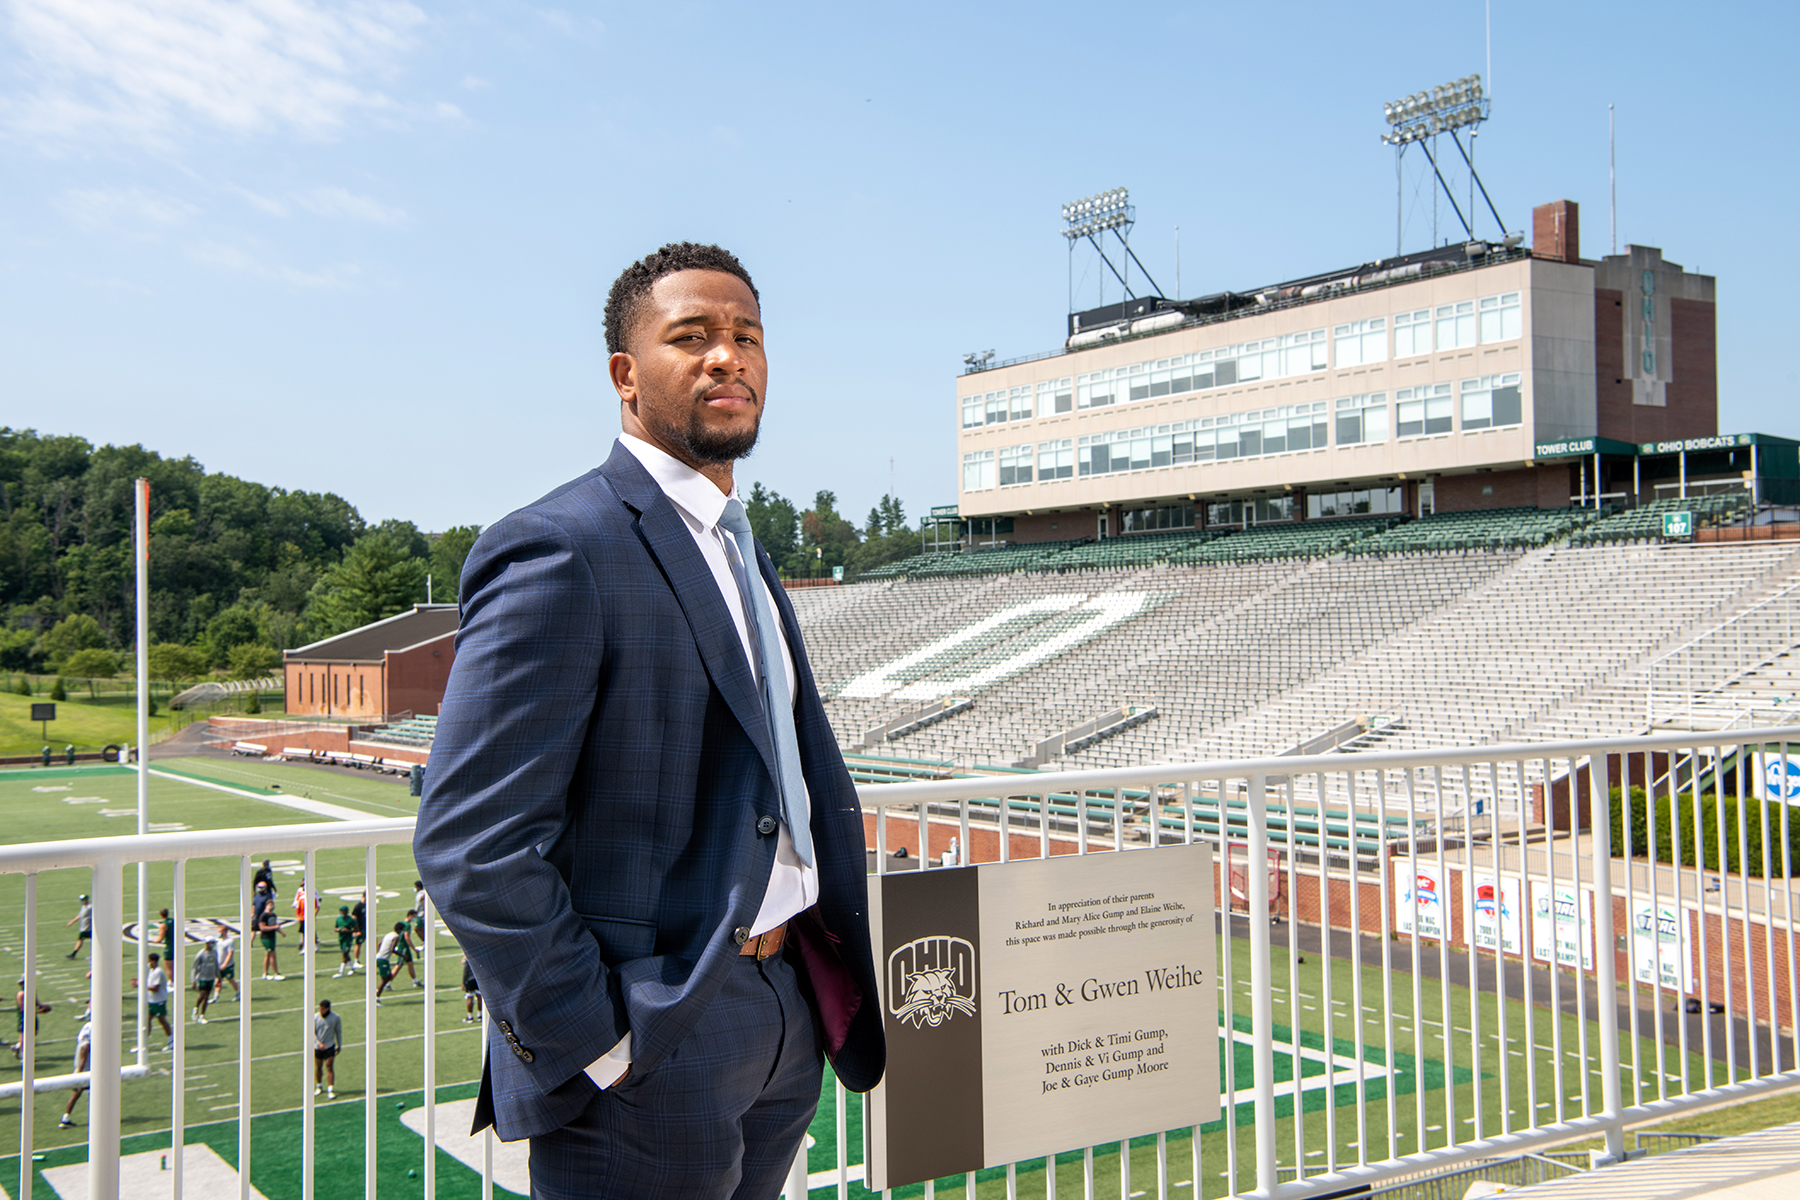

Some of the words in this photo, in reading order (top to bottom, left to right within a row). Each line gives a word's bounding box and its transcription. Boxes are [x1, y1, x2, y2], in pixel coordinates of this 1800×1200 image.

[1642, 271, 1655, 373] OHIO
[1536, 442, 1567, 456] TOWER
[1568, 440, 1594, 453] CLUB
[1657, 441, 1684, 453] OHIO
[1685, 435, 1735, 451] BOBCATS
[1667, 522, 1687, 534] 107
[1015, 918, 1045, 931] Richard
[1046, 916, 1060, 927] and
[1061, 914, 1081, 926] Mary
[1082, 911, 1101, 922] Alice
[1102, 910, 1125, 920] Gump
[1125, 906, 1139, 917] and
[1140, 904, 1161, 915] Elaine
[1162, 901, 1186, 912] Weihe,
[1048, 902, 1057, 912] In
[1058, 897, 1101, 912] appreciation
[1102, 894, 1111, 905] of
[1111, 894, 1128, 904] their
[1130, 892, 1155, 904] parents
[1005, 936, 1020, 947] this
[1021, 935, 1041, 947] space
[1042, 933, 1056, 942] was
[1057, 929, 1077, 941] made
[1078, 925, 1107, 940] possible
[1107, 921, 1137, 934] through
[1137, 920, 1149, 930] the
[1149, 915, 1185, 931] generosity
[1185, 913, 1194, 923] of
[998, 990, 1048, 1015] Tom
[1054, 982, 1075, 1007] &
[1081, 978, 1139, 1002] Gwen
[1145, 964, 1203, 992] Weihe
[1041, 1043, 1065, 1057] with
[1067, 1038, 1092, 1053] Dick
[1095, 1036, 1104, 1048] &
[1107, 1031, 1132, 1046] Timi
[1134, 1029, 1169, 1042] Gump,
[1045, 1057, 1082, 1074] Dennis
[1084, 1055, 1095, 1067] &
[1097, 1051, 1110, 1065] Vi
[1112, 1049, 1144, 1062] Gump
[1146, 1042, 1164, 1056] and
[1041, 1080, 1058, 1095] Joe
[1061, 1076, 1071, 1089] &
[1074, 1074, 1099, 1088] Gaye
[1102, 1069, 1134, 1080] Gump
[1136, 1061, 1170, 1075] Moore
